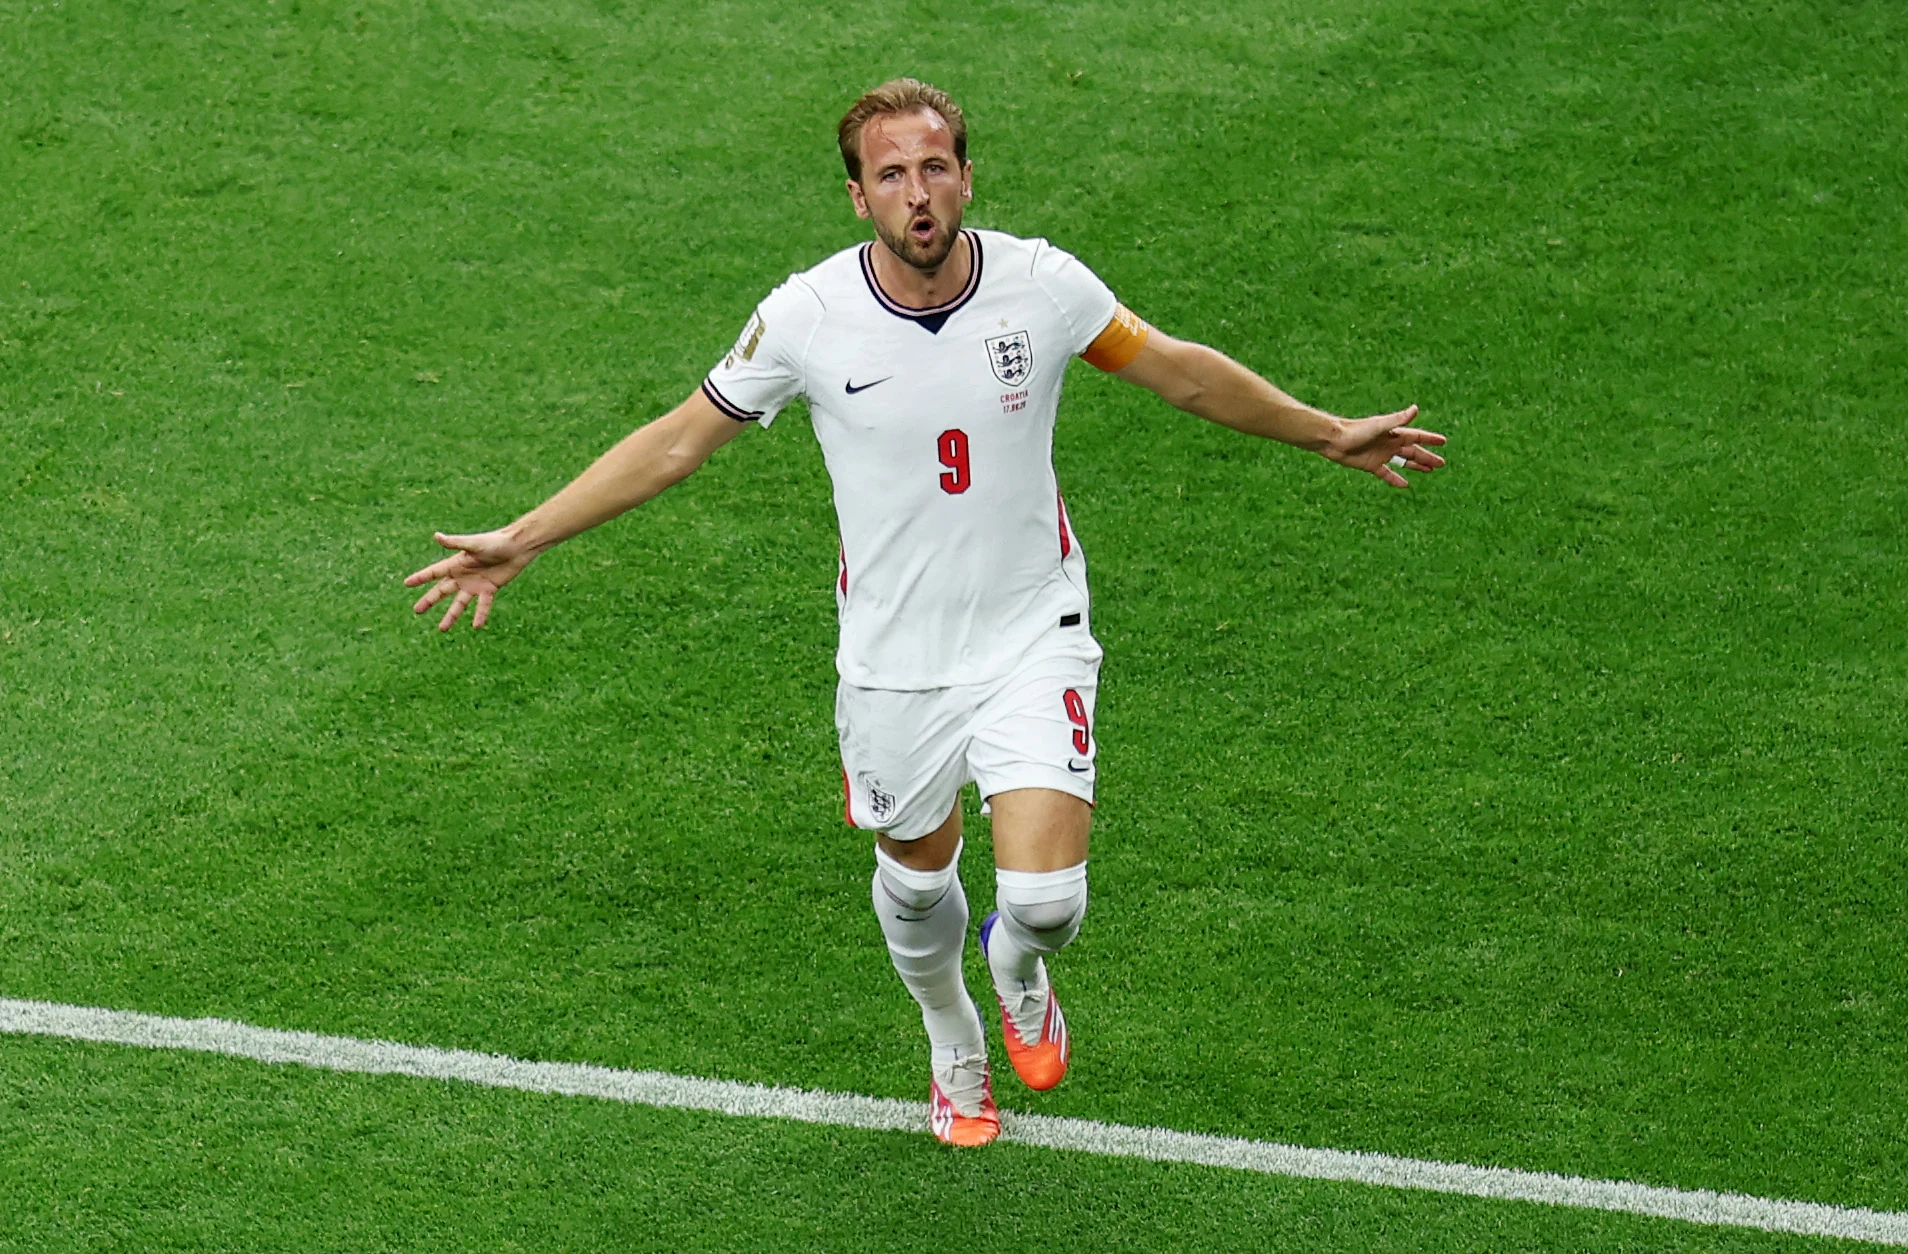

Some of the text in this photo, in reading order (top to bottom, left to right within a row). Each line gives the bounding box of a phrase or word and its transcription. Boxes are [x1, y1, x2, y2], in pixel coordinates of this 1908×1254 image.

[1000, 389, 1029, 403] CROATIA
[937, 428, 971, 495] 9
[1063, 688, 1089, 756] 9
